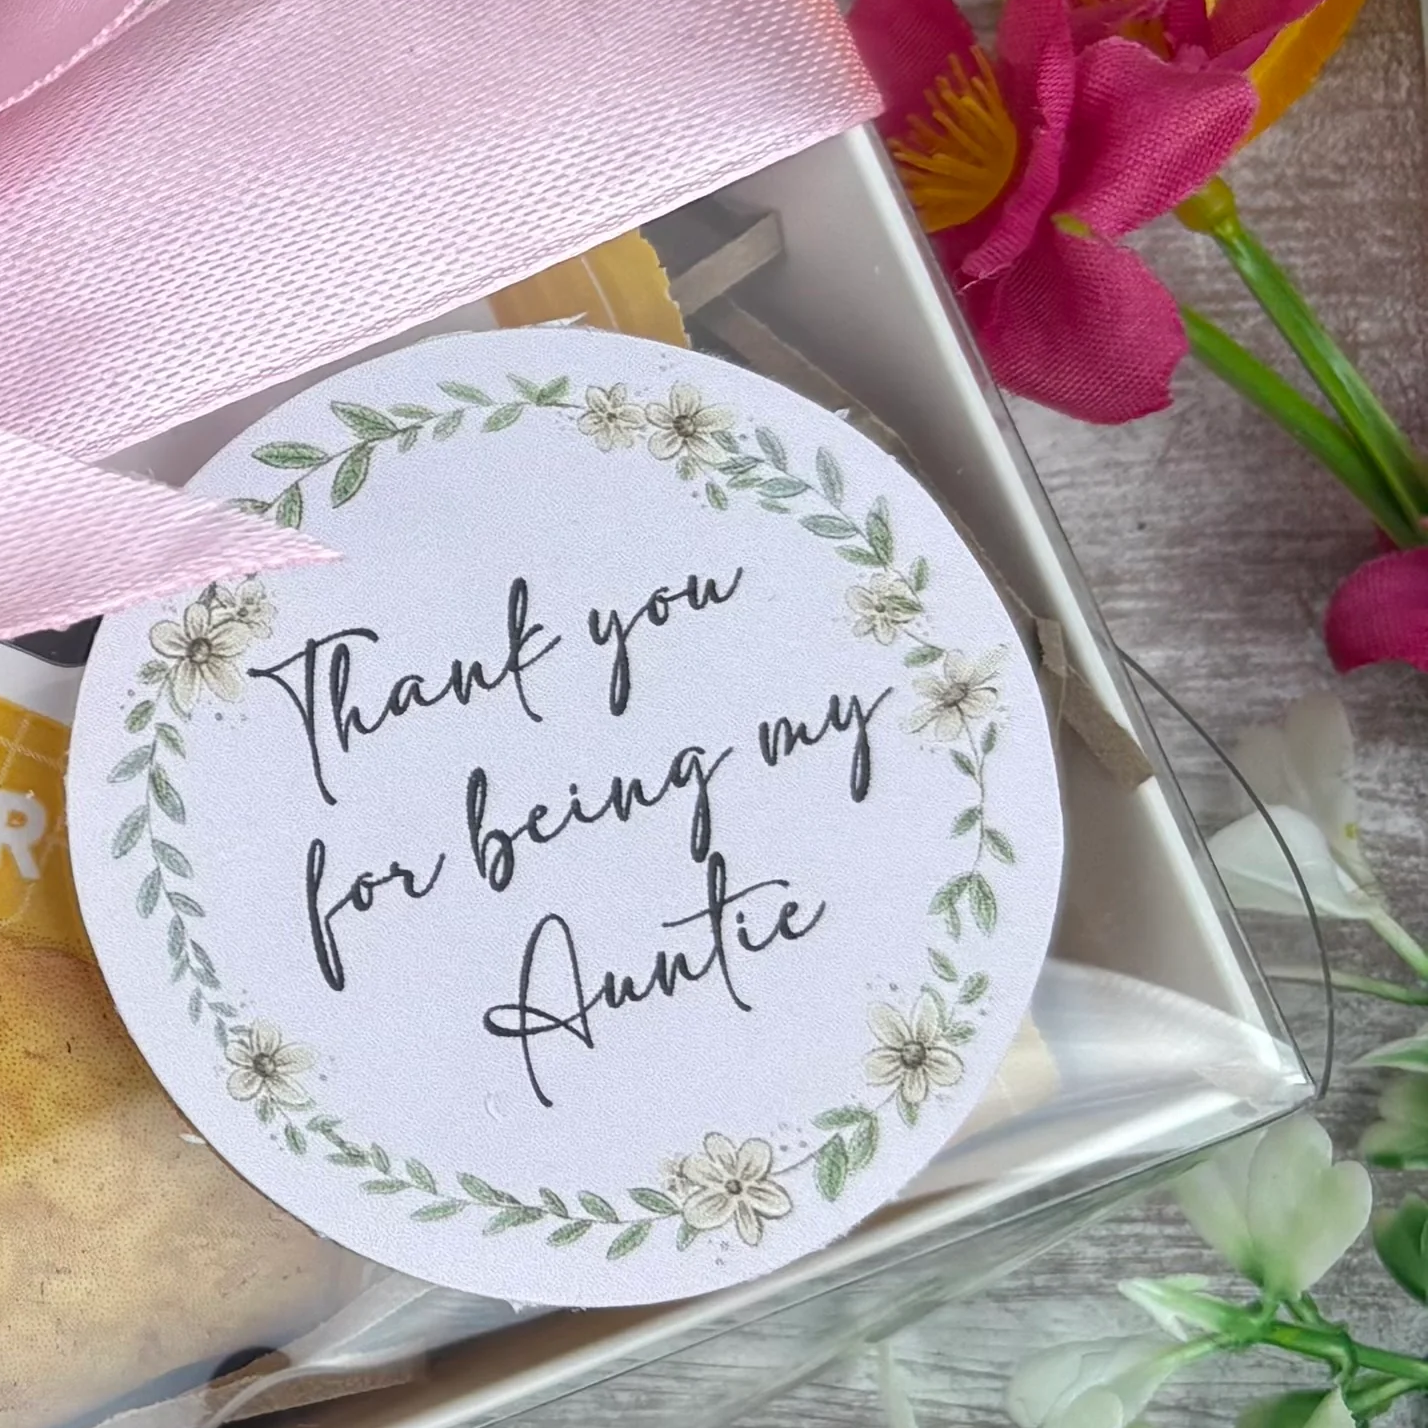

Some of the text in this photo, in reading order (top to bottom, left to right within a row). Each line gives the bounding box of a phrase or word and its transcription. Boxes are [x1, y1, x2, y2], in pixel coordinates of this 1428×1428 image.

[249, 567, 744, 806] Thank you
[304, 686, 892, 992] for being my
[483, 852, 826, 1108] Auntie
